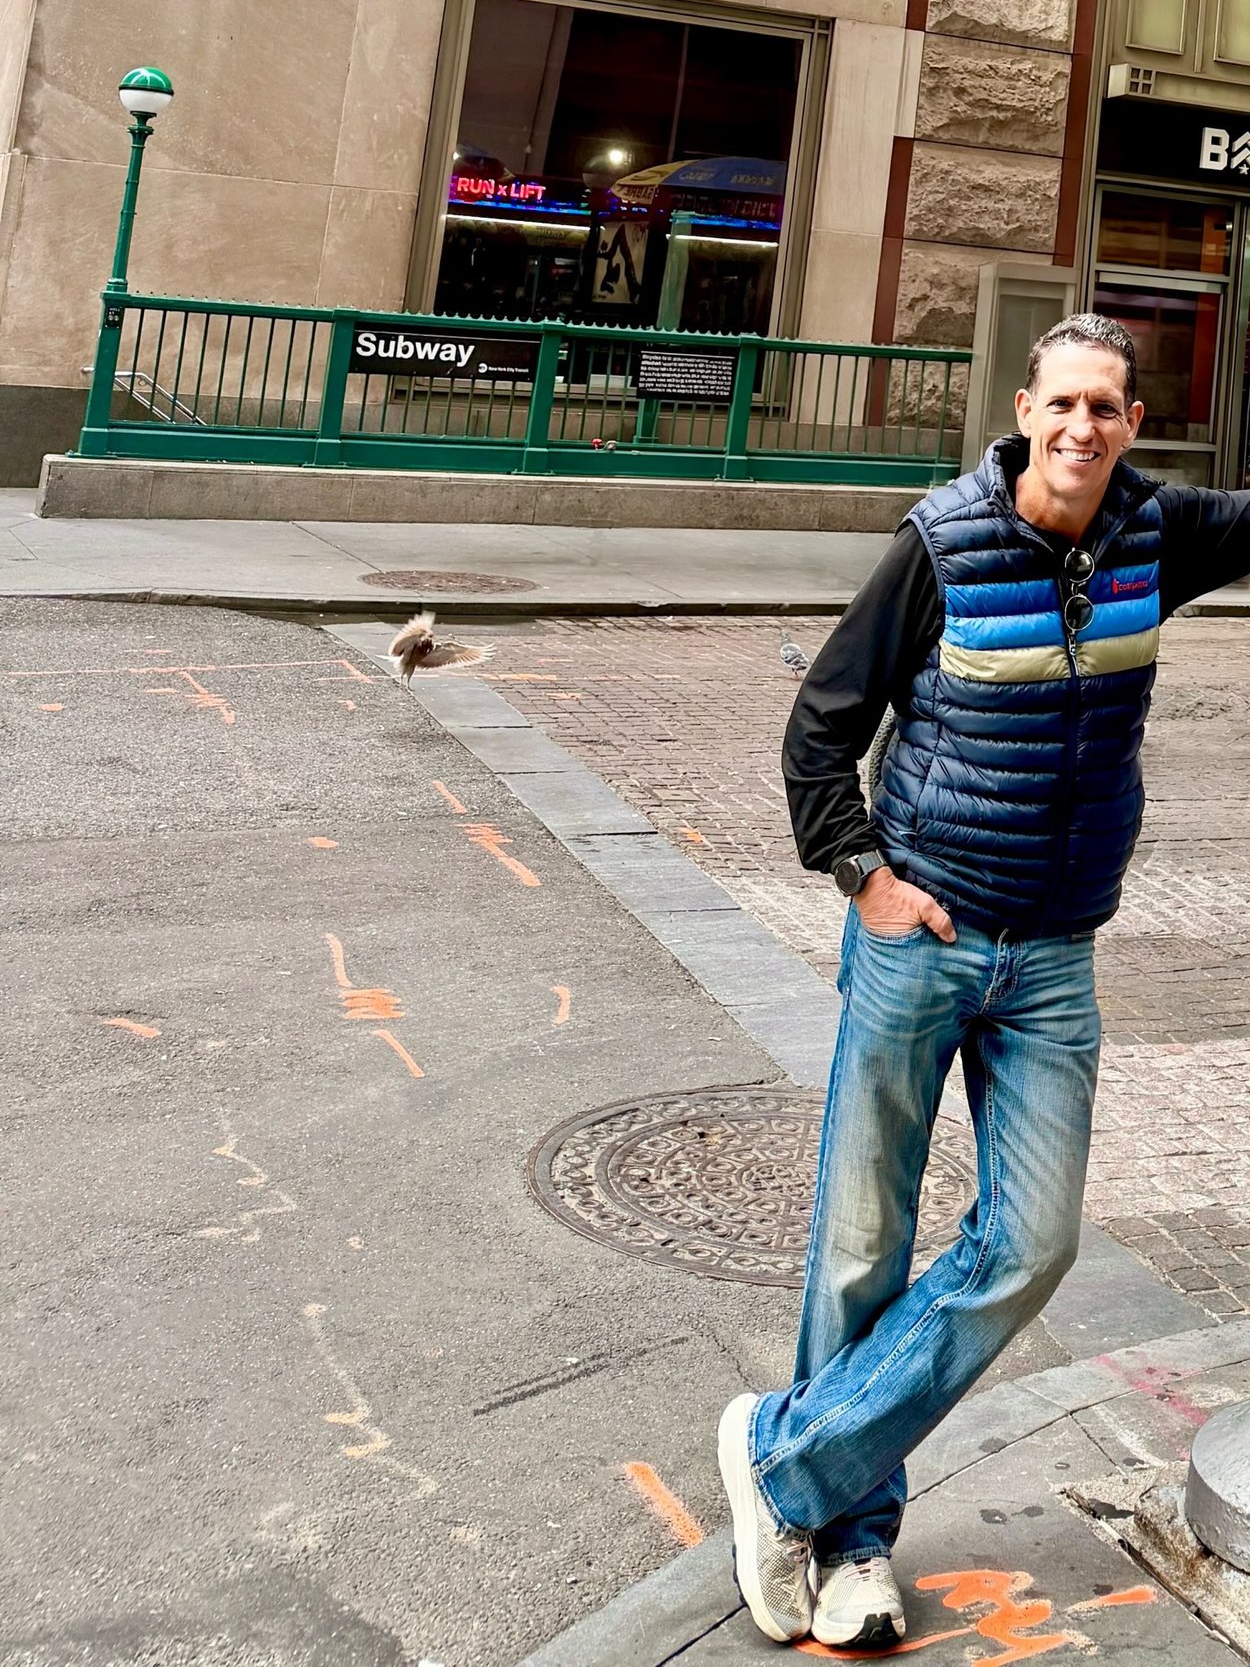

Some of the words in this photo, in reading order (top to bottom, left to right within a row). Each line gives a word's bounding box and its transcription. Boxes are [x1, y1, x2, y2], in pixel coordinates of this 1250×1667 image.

[457, 177, 495, 194] RUN
[510, 183, 546, 200] LIFT
[355, 332, 475, 367] Subway
